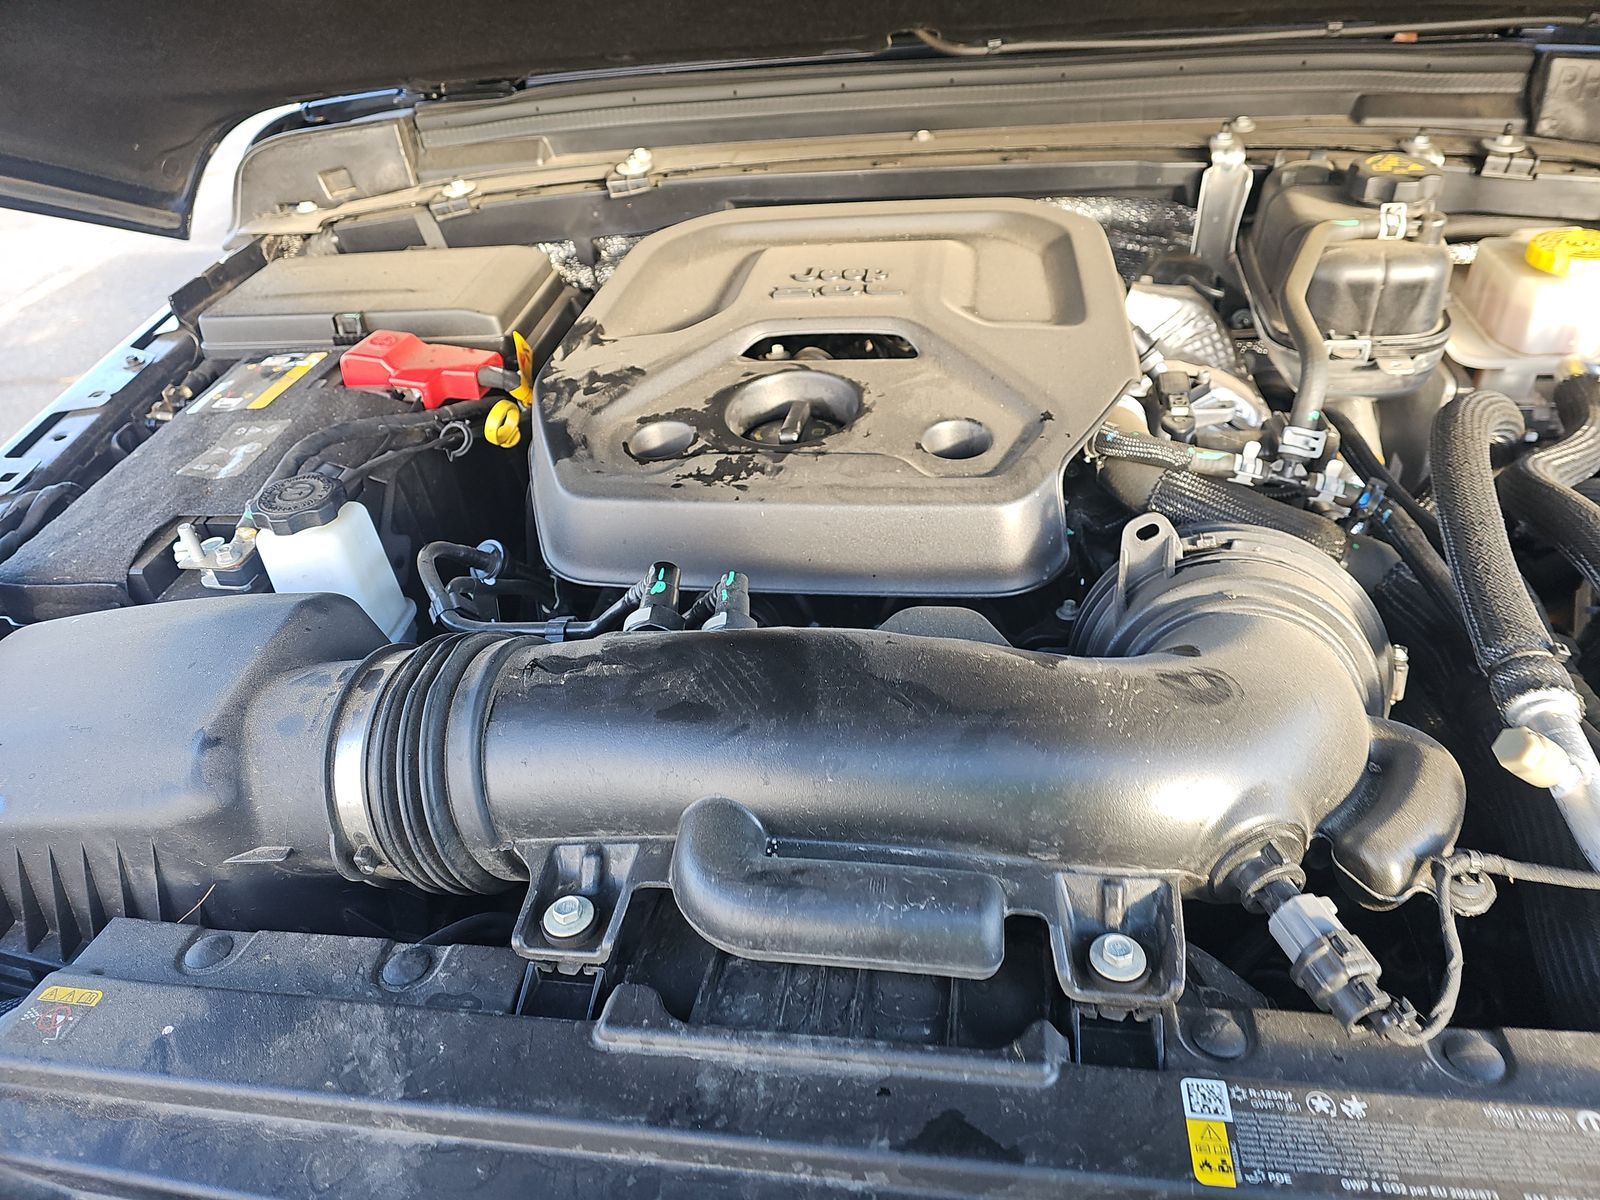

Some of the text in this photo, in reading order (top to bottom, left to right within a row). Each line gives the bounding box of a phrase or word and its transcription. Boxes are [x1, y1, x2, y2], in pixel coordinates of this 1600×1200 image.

[1267, 1171, 1292, 1184] POE
[1340, 1178, 1369, 1191] GWP
[1429, 1185, 1448, 1198] EU
